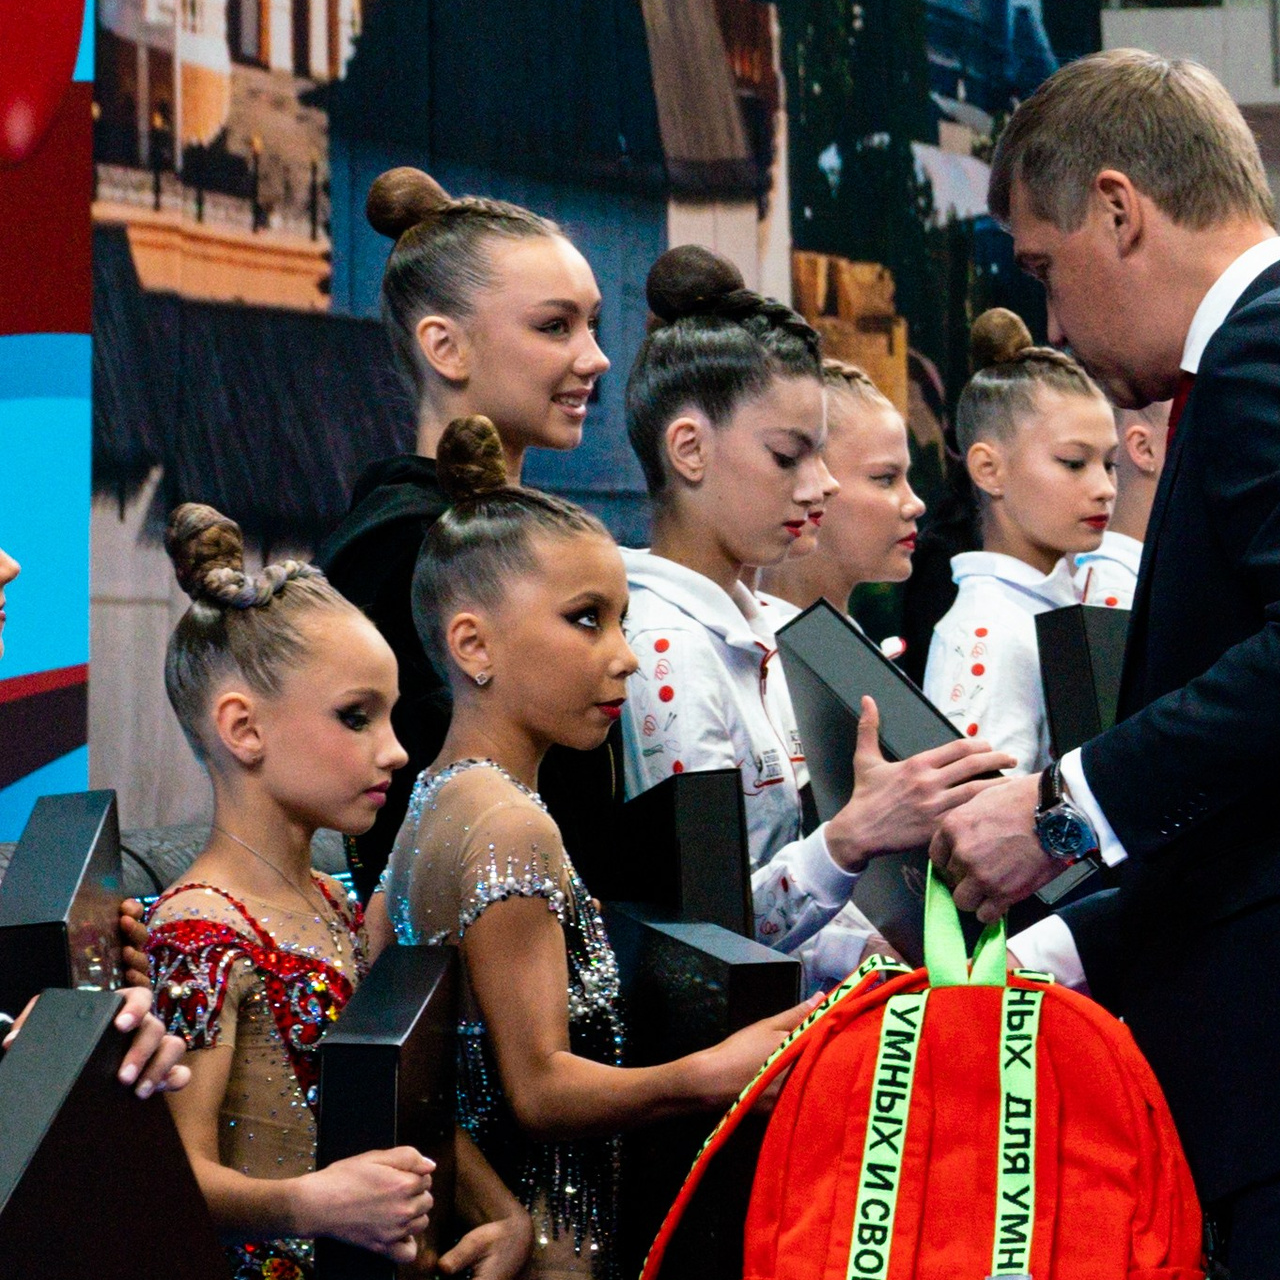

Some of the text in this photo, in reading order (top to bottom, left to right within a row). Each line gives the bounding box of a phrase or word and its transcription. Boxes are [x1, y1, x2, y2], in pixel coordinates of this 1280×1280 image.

[868, 1005, 920, 1155] УМНЫХ
[1002, 1092, 1032, 1175] ДЛЯ
[864, 1162, 897, 1192] И
